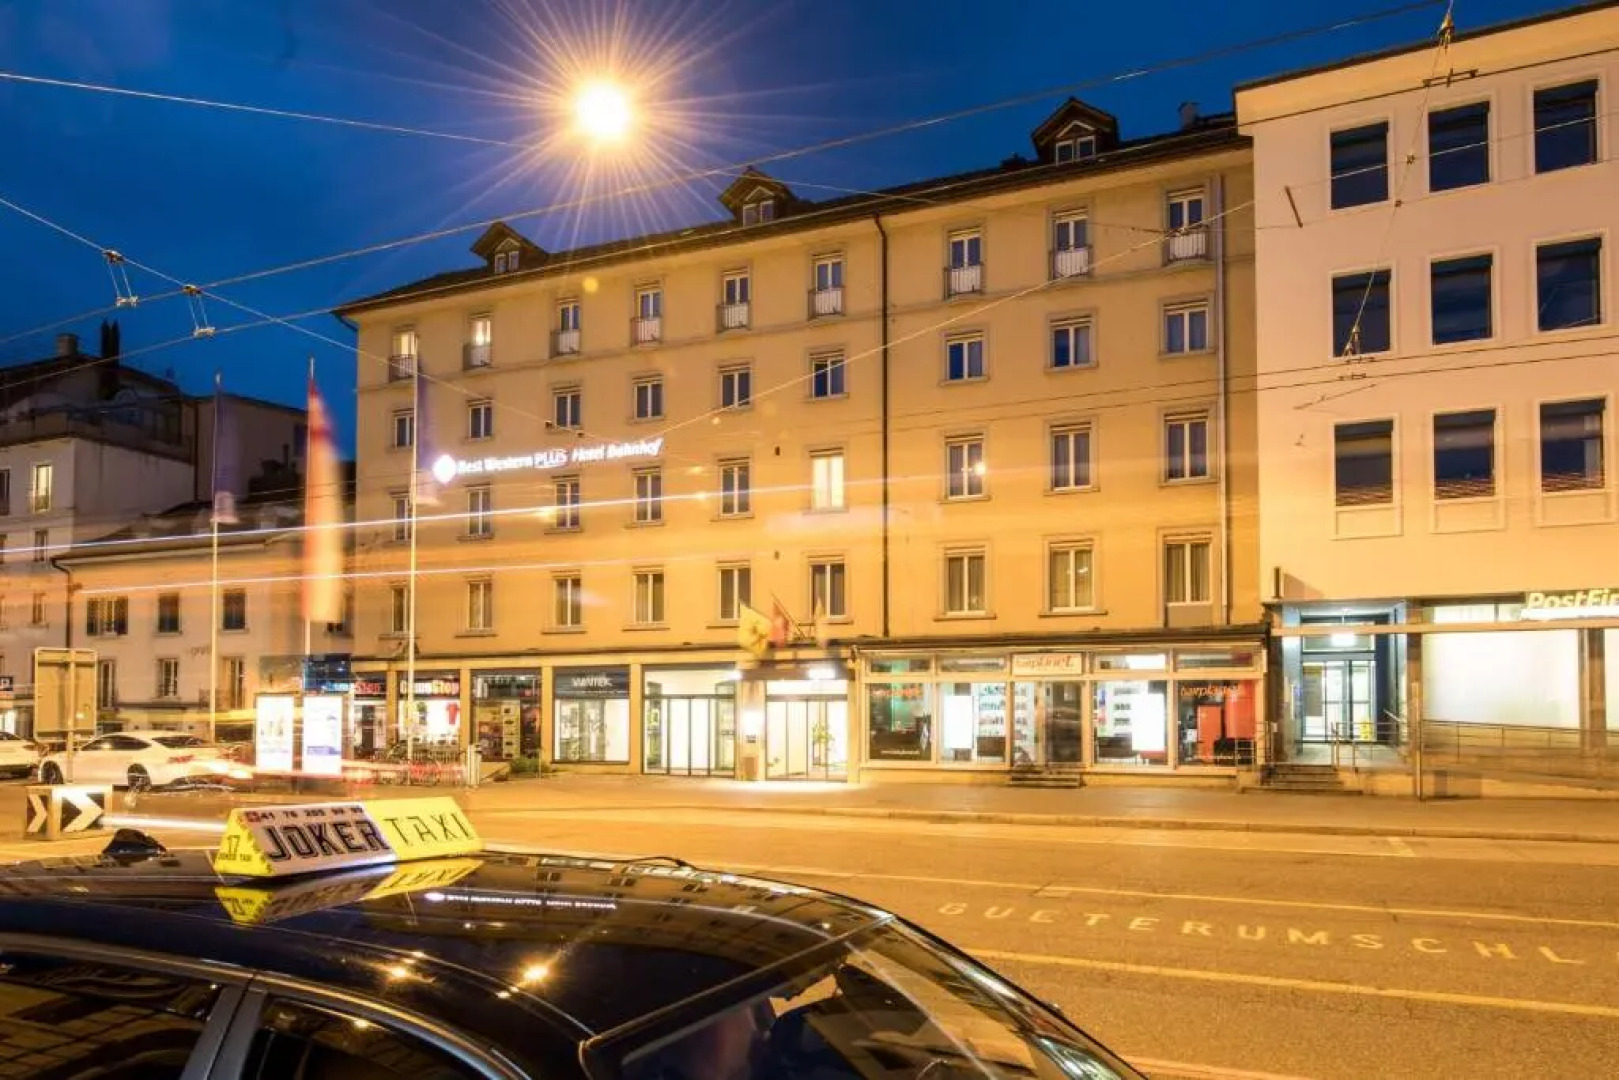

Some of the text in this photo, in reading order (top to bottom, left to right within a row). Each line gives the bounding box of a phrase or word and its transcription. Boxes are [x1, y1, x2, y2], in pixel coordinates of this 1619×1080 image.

[533, 448, 569, 469] PLUS
[571, 443, 605, 462] Hotel
[399, 679, 460, 695] GmeStop
[265, 812, 474, 861] JOKER TAXI
[938, 902, 1619, 966] GUETERUMSCHL
